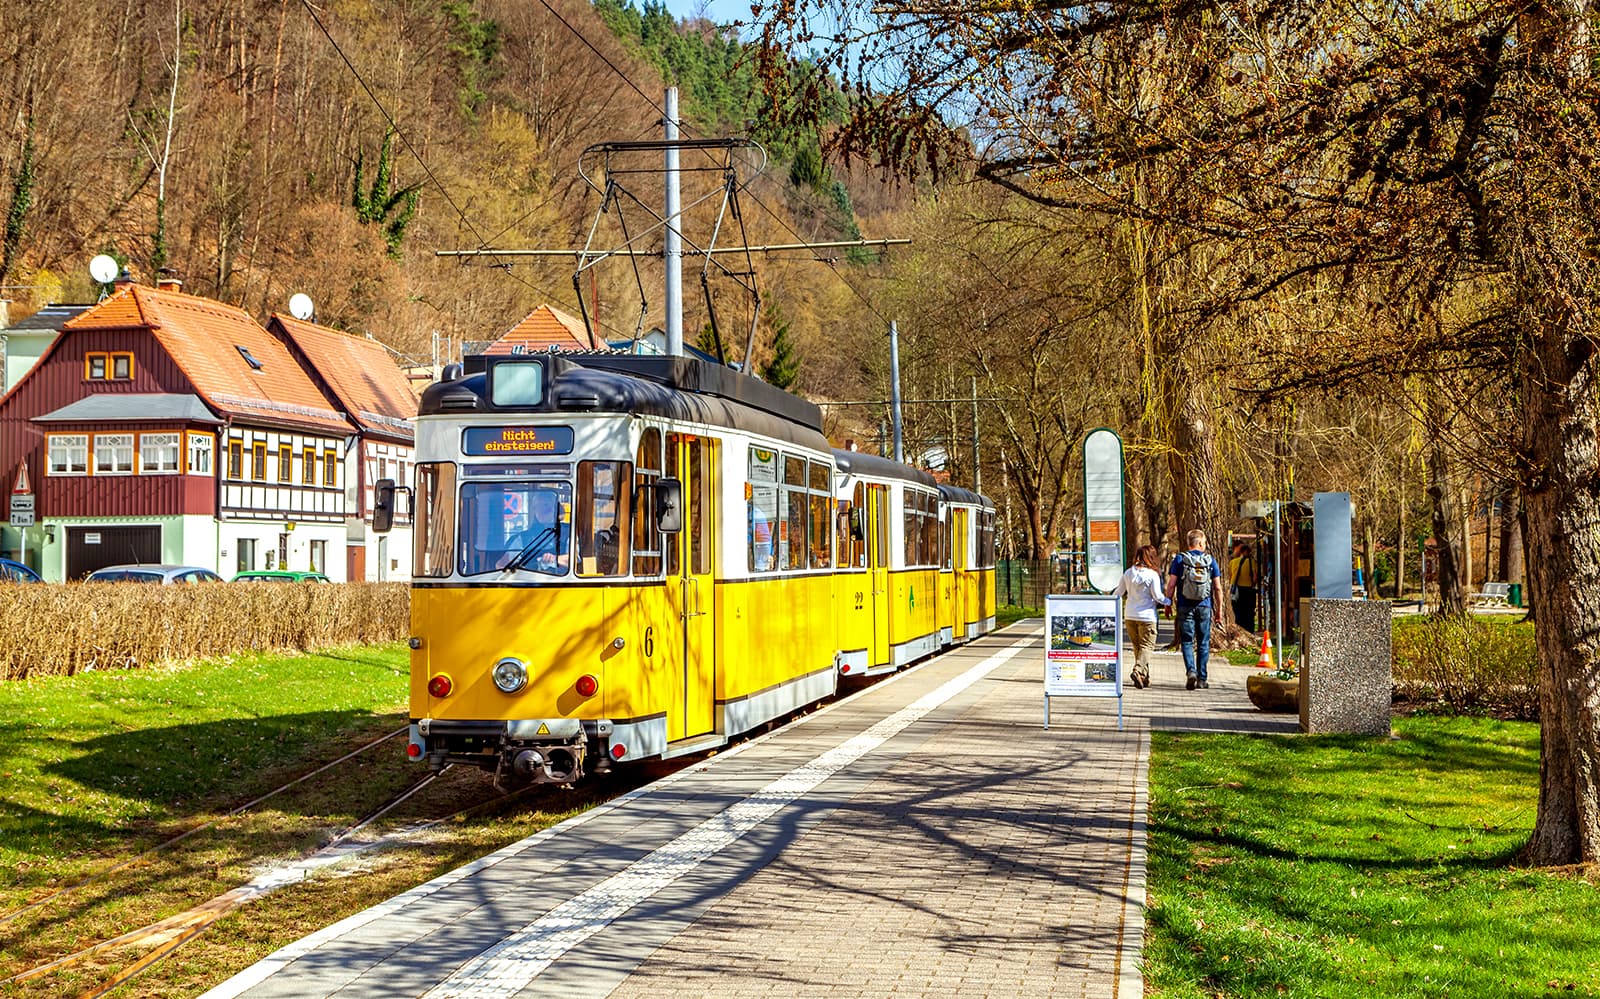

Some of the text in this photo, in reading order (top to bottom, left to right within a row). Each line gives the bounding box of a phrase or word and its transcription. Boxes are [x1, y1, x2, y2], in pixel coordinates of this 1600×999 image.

[503, 430, 535, 441] Nicht
[485, 440, 554, 451] einsteigen!
[644, 626, 653, 658] 6
